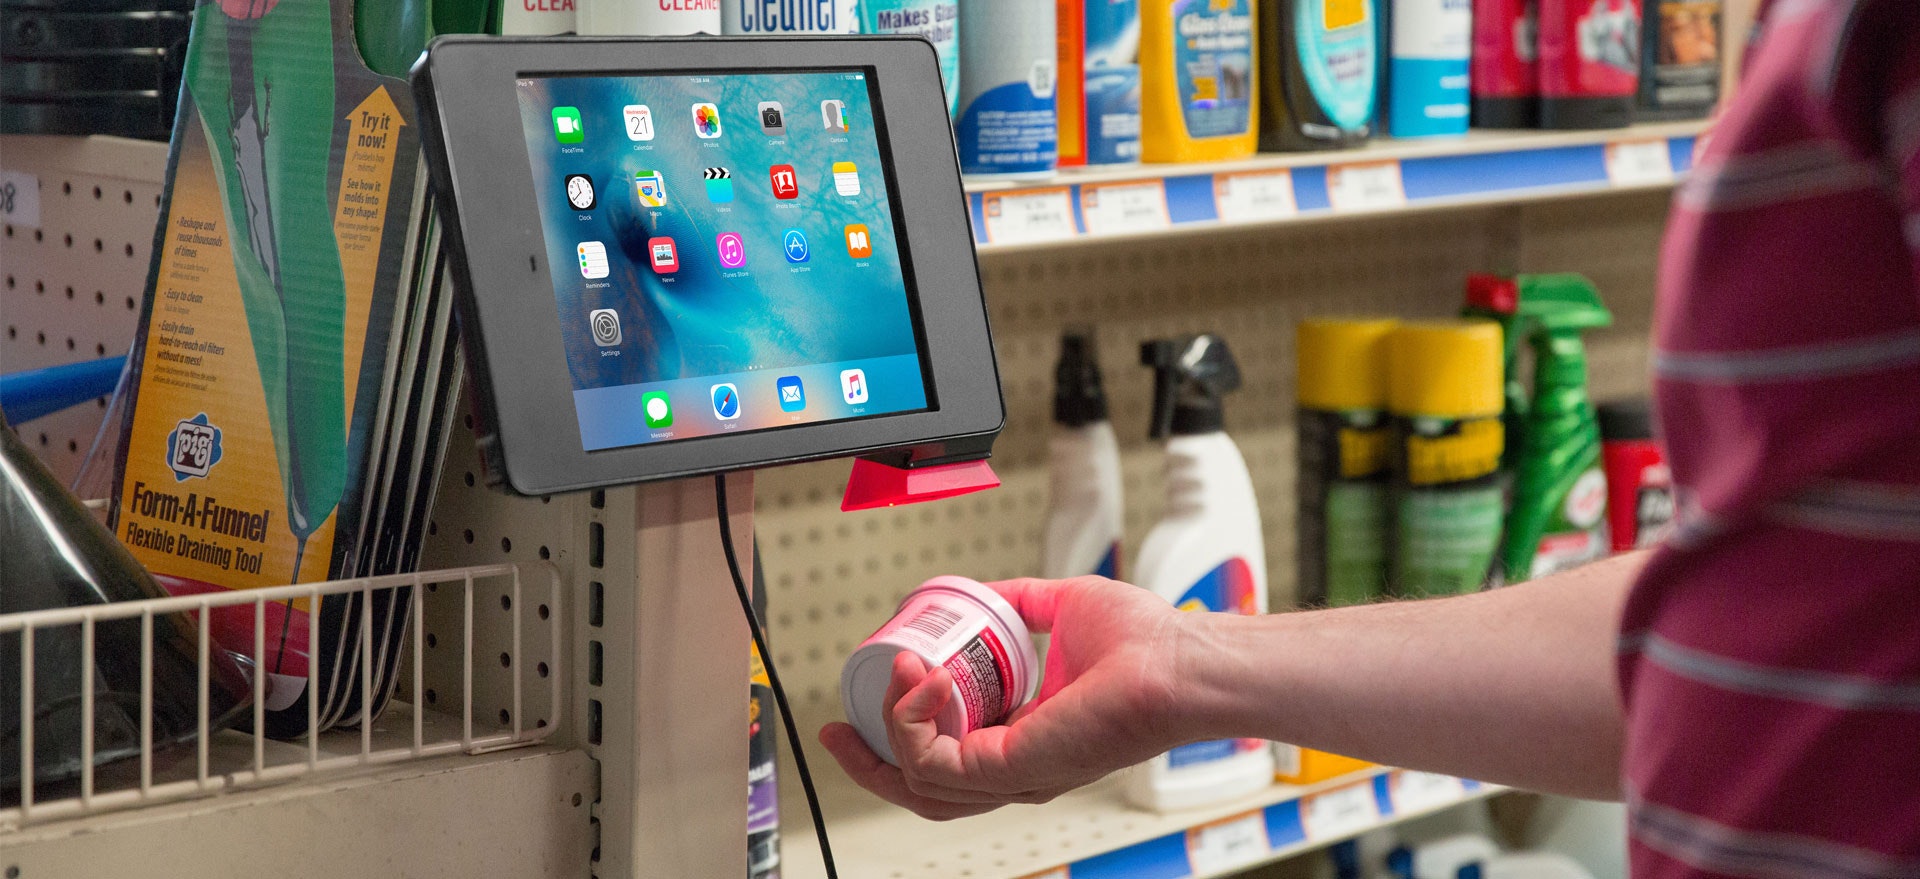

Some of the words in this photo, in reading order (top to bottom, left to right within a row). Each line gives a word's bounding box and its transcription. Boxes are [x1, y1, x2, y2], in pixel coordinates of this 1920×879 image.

[878, 9, 929, 30] Makes
[362, 111, 379, 133] Try
[380, 113, 391, 130] it
[631, 116, 649, 135] 21
[358, 133, 387, 149] now!
[347, 178, 359, 190] See
[360, 179, 374, 191] how
[375, 181, 382, 192] it
[344, 192, 364, 204] molds
[365, 194, 379, 205] into
[343, 207, 355, 218] any
[356, 207, 378, 220] shape!
[179, 216, 203, 232] Reshape
[203, 221, 217, 231] and
[177, 232, 192, 243] reuse
[192, 233, 223, 247] thousands
[174, 245, 182, 256] of
[181, 248, 197, 258] times
[166, 288, 180, 303] Easy
[180, 291, 188, 301] to
[187, 291, 204, 304] clean
[161, 320, 178, 335] Easily
[178, 323, 195, 336] drain
[159, 334, 199, 351] hard-to-reach
[198, 341, 208, 352] oil
[207, 343, 225, 356] filters
[601, 349, 620, 357] Settings
[157, 349, 180, 363] without
[184, 355, 203, 366] mess!
[724, 422, 737, 430] Safari
[651, 430, 674, 439] Messages
[177, 426, 213, 467] pig
[131, 481, 270, 544] Form-A-Funnel
[126, 522, 175, 554] Flexible
[176, 534, 233, 570] Draining
[235, 547, 263, 575] Tool
